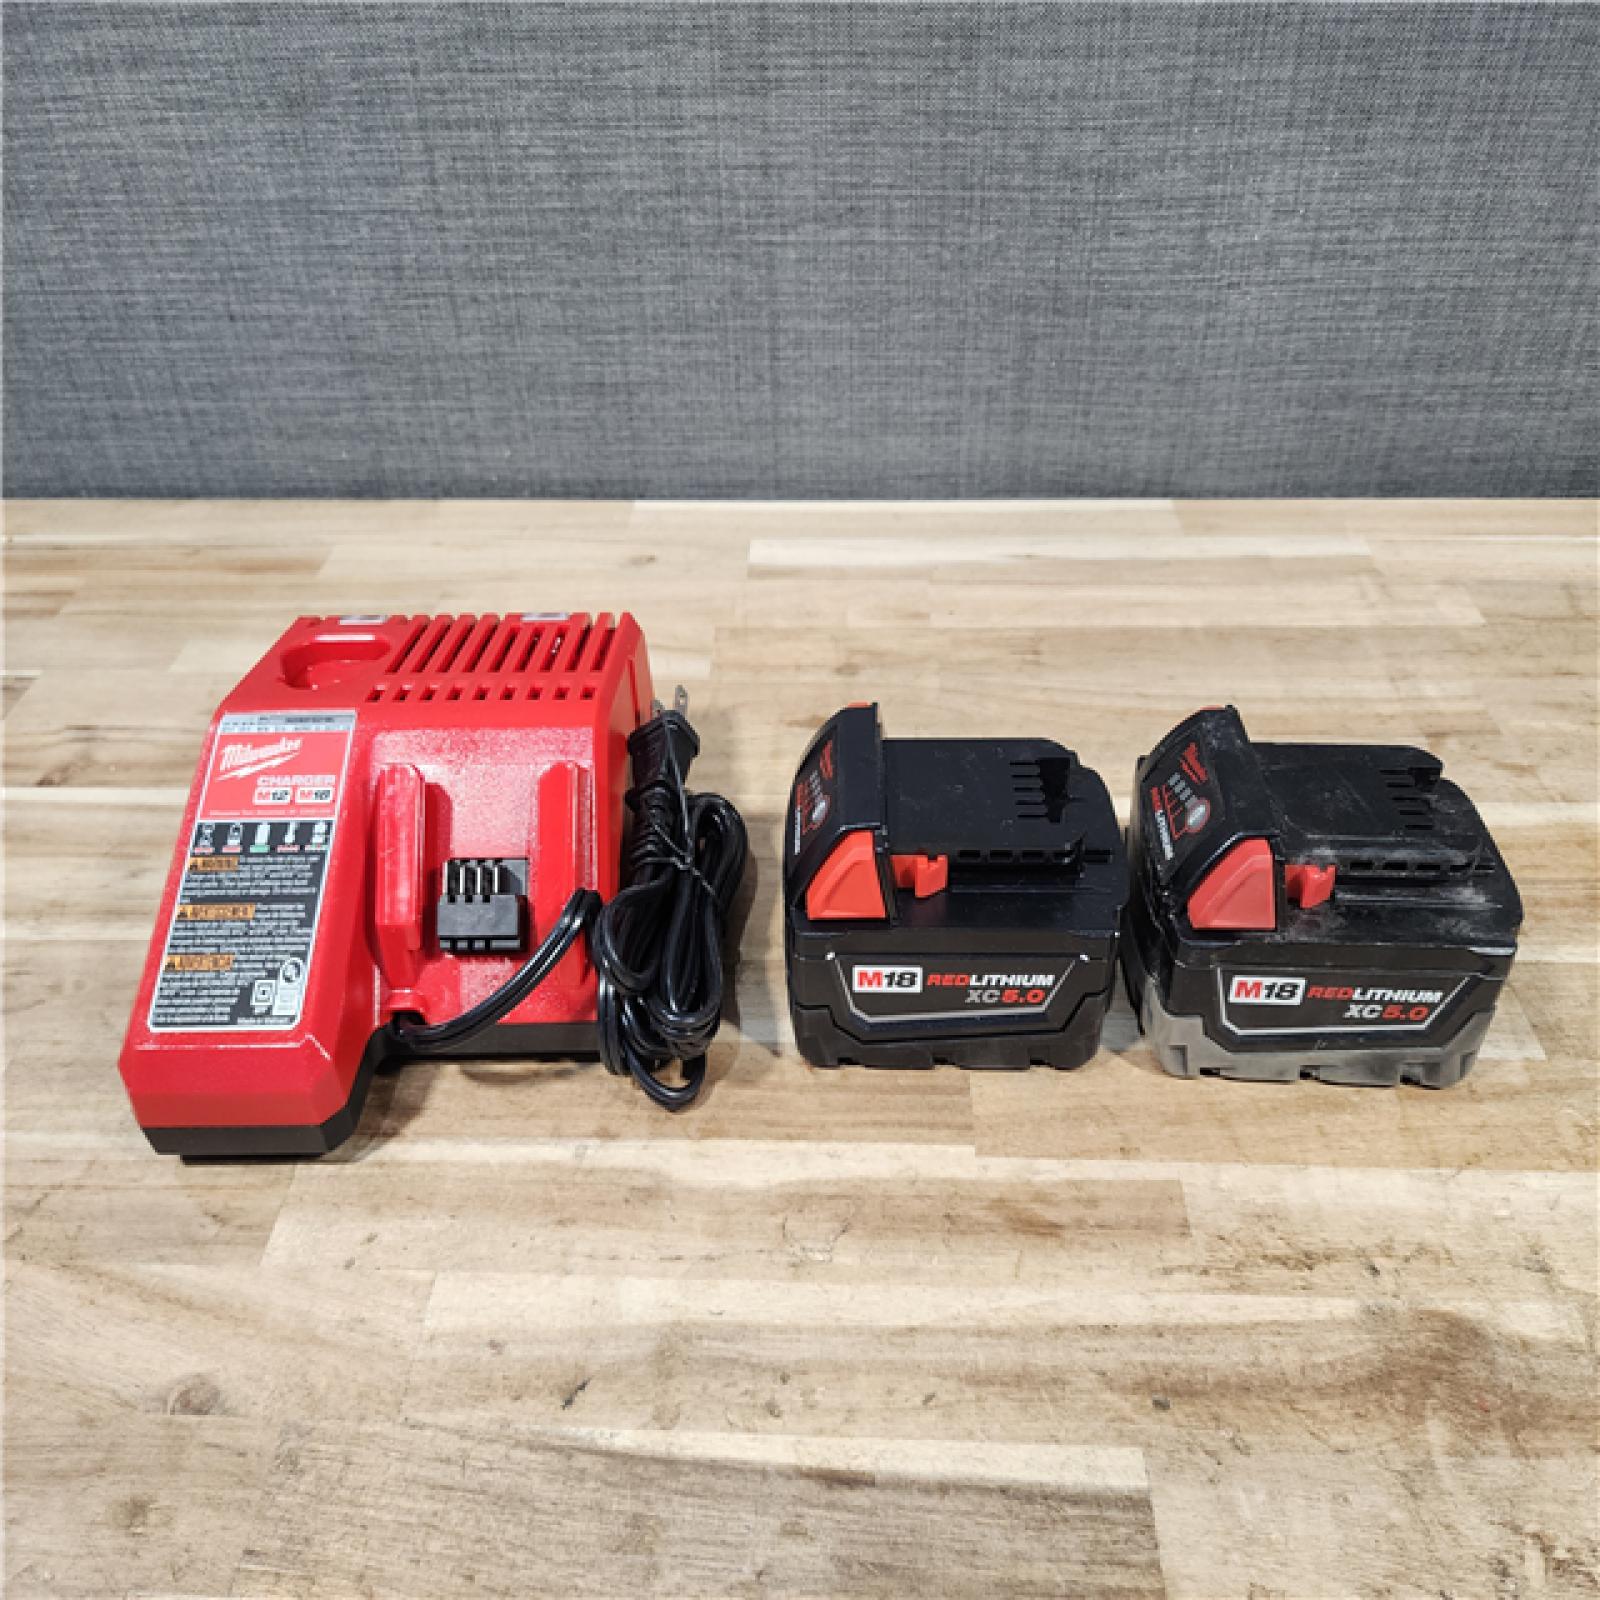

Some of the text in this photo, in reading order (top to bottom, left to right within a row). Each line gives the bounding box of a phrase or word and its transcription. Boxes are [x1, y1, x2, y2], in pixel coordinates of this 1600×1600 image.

[257, 775, 336, 786] CHARGER
[857, 970, 918, 988] M18
[1234, 979, 1300, 1000] M18
